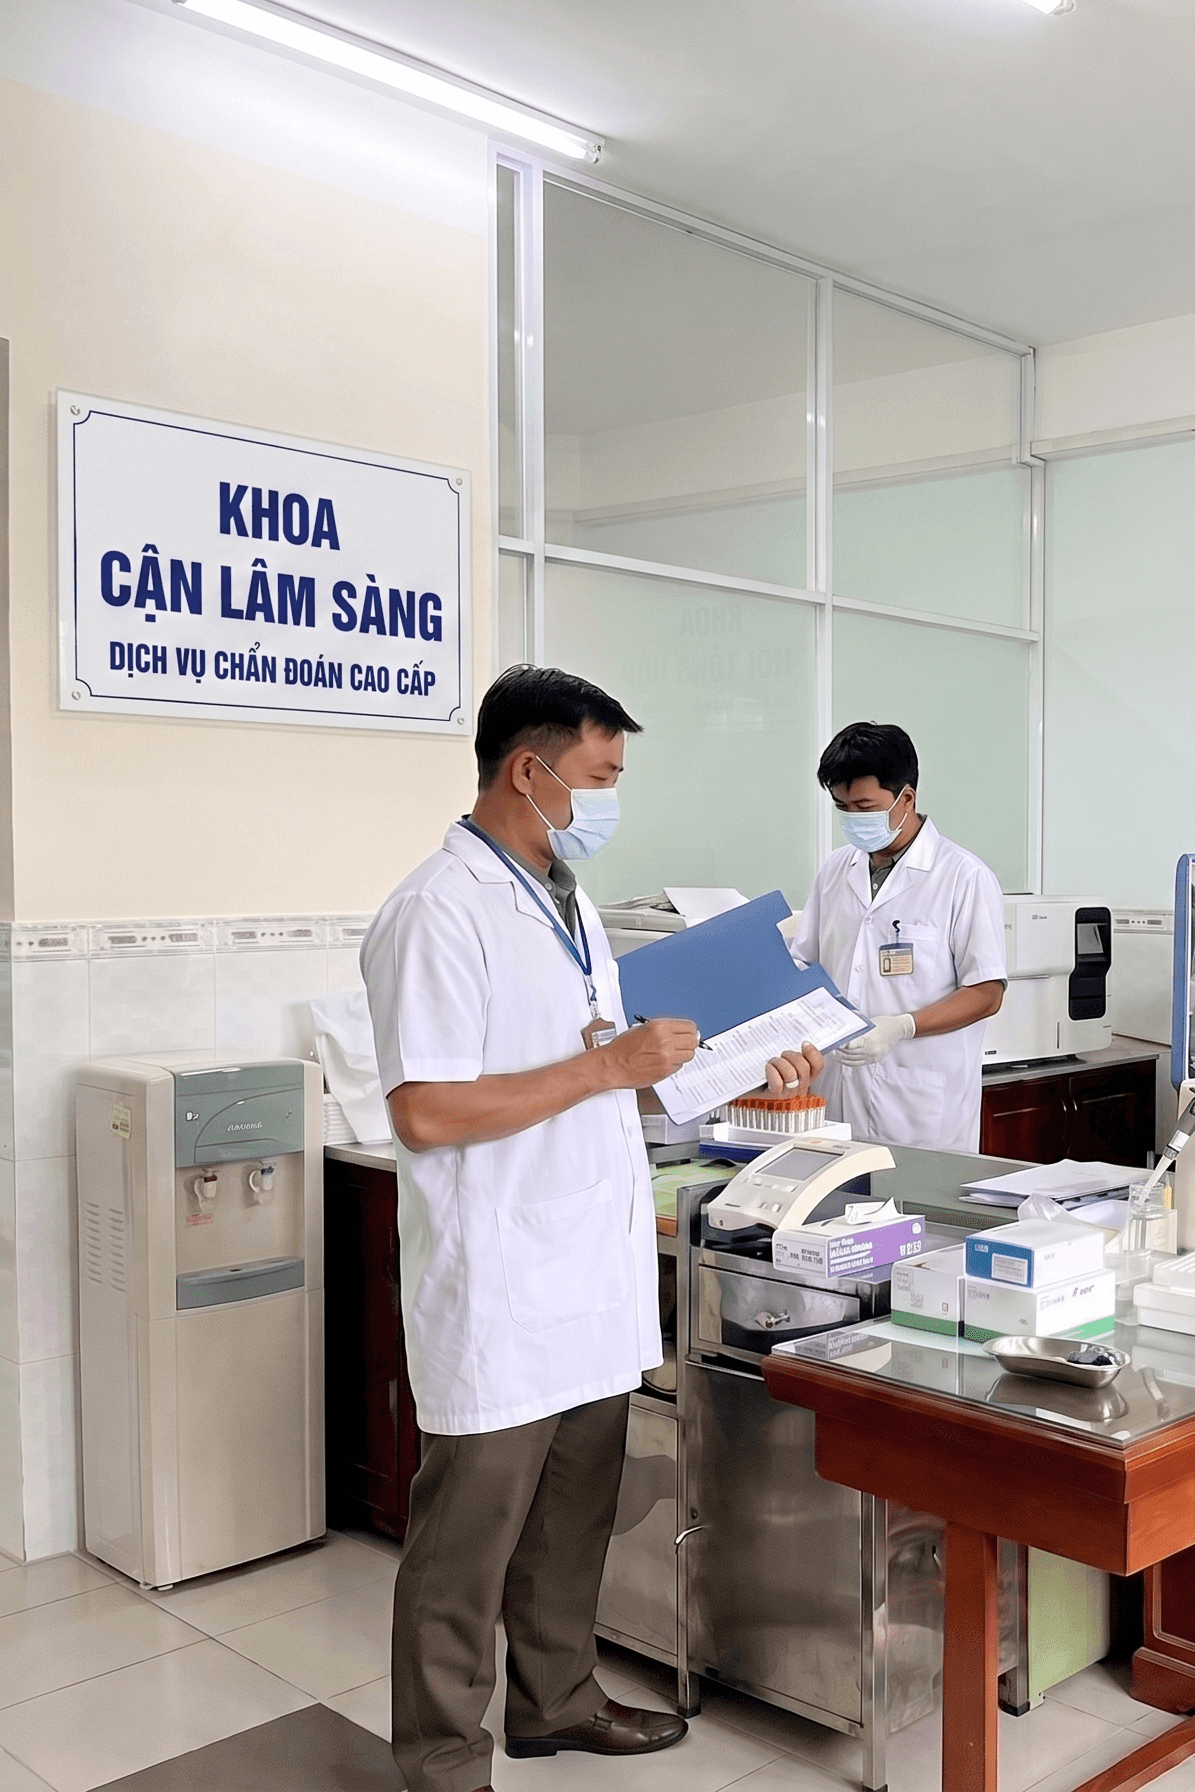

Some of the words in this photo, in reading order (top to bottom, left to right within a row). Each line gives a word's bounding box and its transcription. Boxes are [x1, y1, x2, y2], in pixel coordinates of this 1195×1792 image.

[220, 481, 340, 551] KHOA
[101, 543, 203, 622] CẬN
[220, 558, 316, 628] LÂM
[332, 573, 443, 642] SÀNG
[109, 641, 168, 678] DỊCH
[175, 647, 206, 685] VỤ
[214, 641, 277, 684] CHẨN
[284, 655, 343, 690] ĐOÁN
[350, 664, 390, 694] CAO
[396, 659, 436, 697] CẤP
